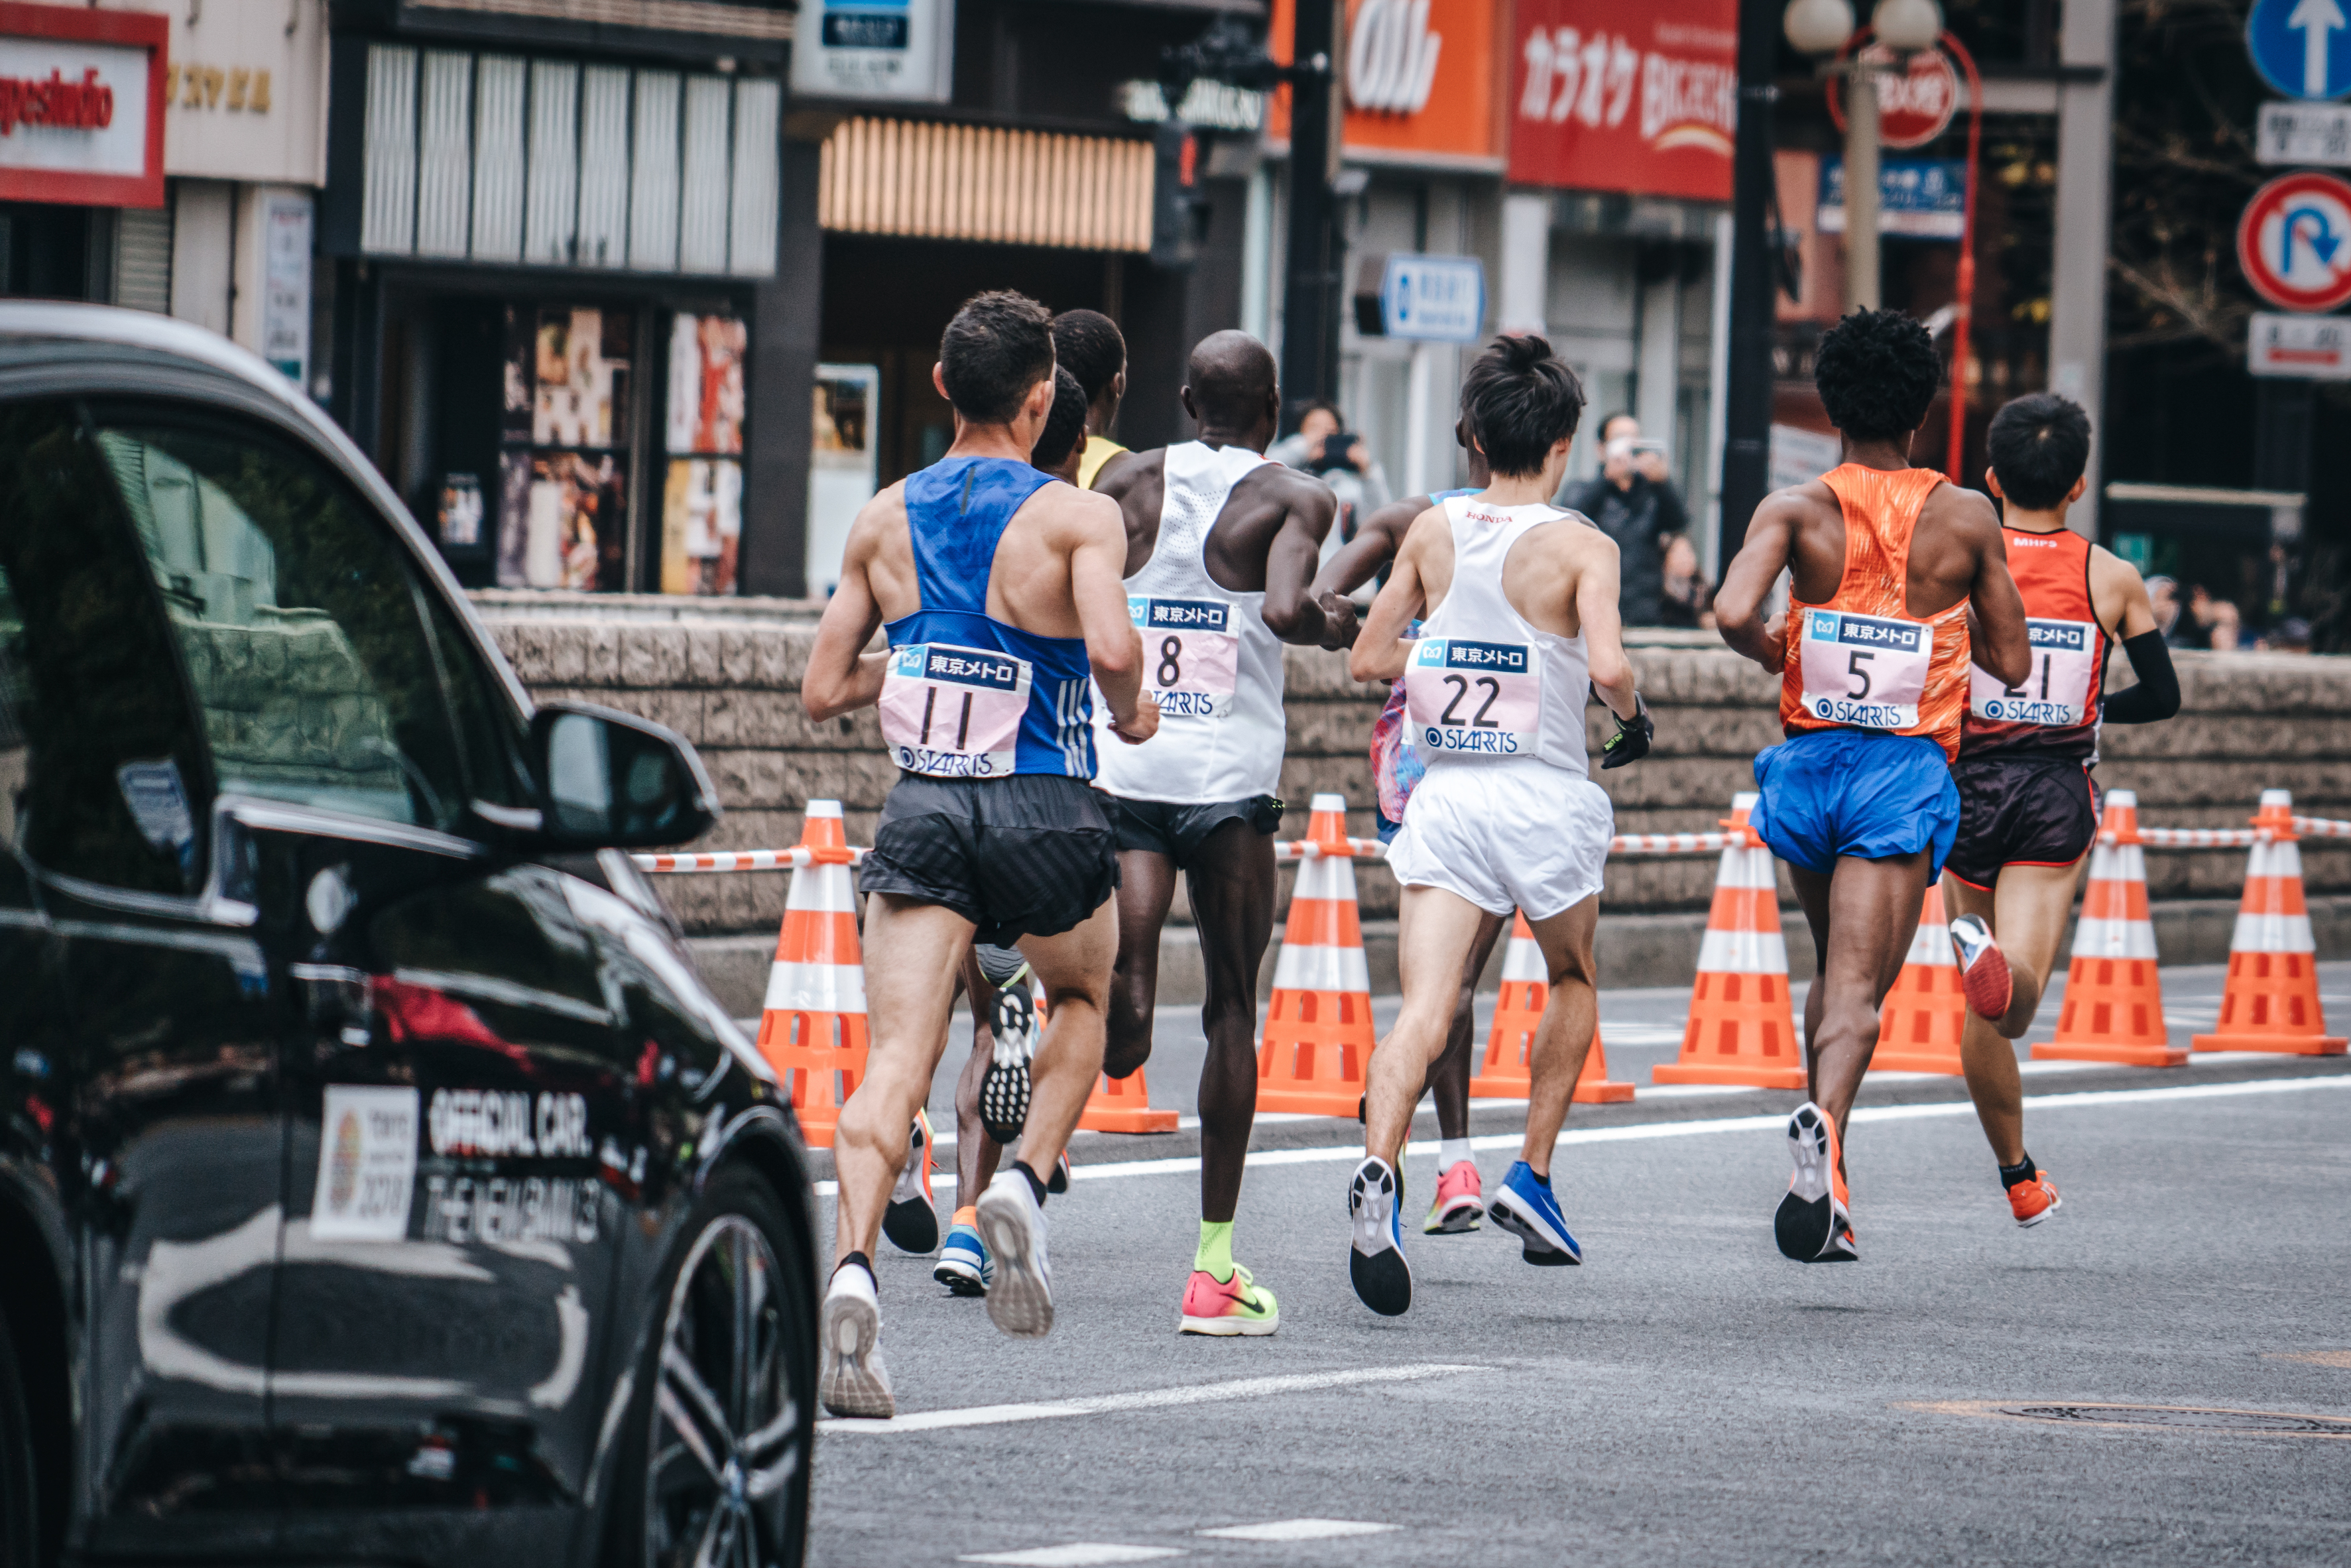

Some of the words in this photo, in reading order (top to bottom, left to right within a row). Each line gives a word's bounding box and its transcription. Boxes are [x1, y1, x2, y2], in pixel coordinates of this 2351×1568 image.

[1521, 25, 1638, 128] カラオケ
[1467, 511, 1512, 523] HONDA
[2013, 537, 2058, 548] MHPS
[1154, 605, 1223, 625] 東京メトロ
[1843, 623, 1915, 645] 東京メトロ
[2027, 627, 2080, 644] 京メトロ
[929, 654, 1013, 682] 東京メトロ
[1157, 635, 1181, 687] 8
[1451, 647, 1523, 666] 東京メトロ
[1846, 650, 1875, 700] 5
[1152, 690, 1213, 715] TARTS
[1441, 674, 1500, 728] 22
[1835, 701, 1901, 726] STARTS
[2006, 701, 2070, 723] STARTS
[920, 686, 973, 750] 11
[1445, 729, 1517, 753] STARTS
[918, 749, 993, 776] STARTS
